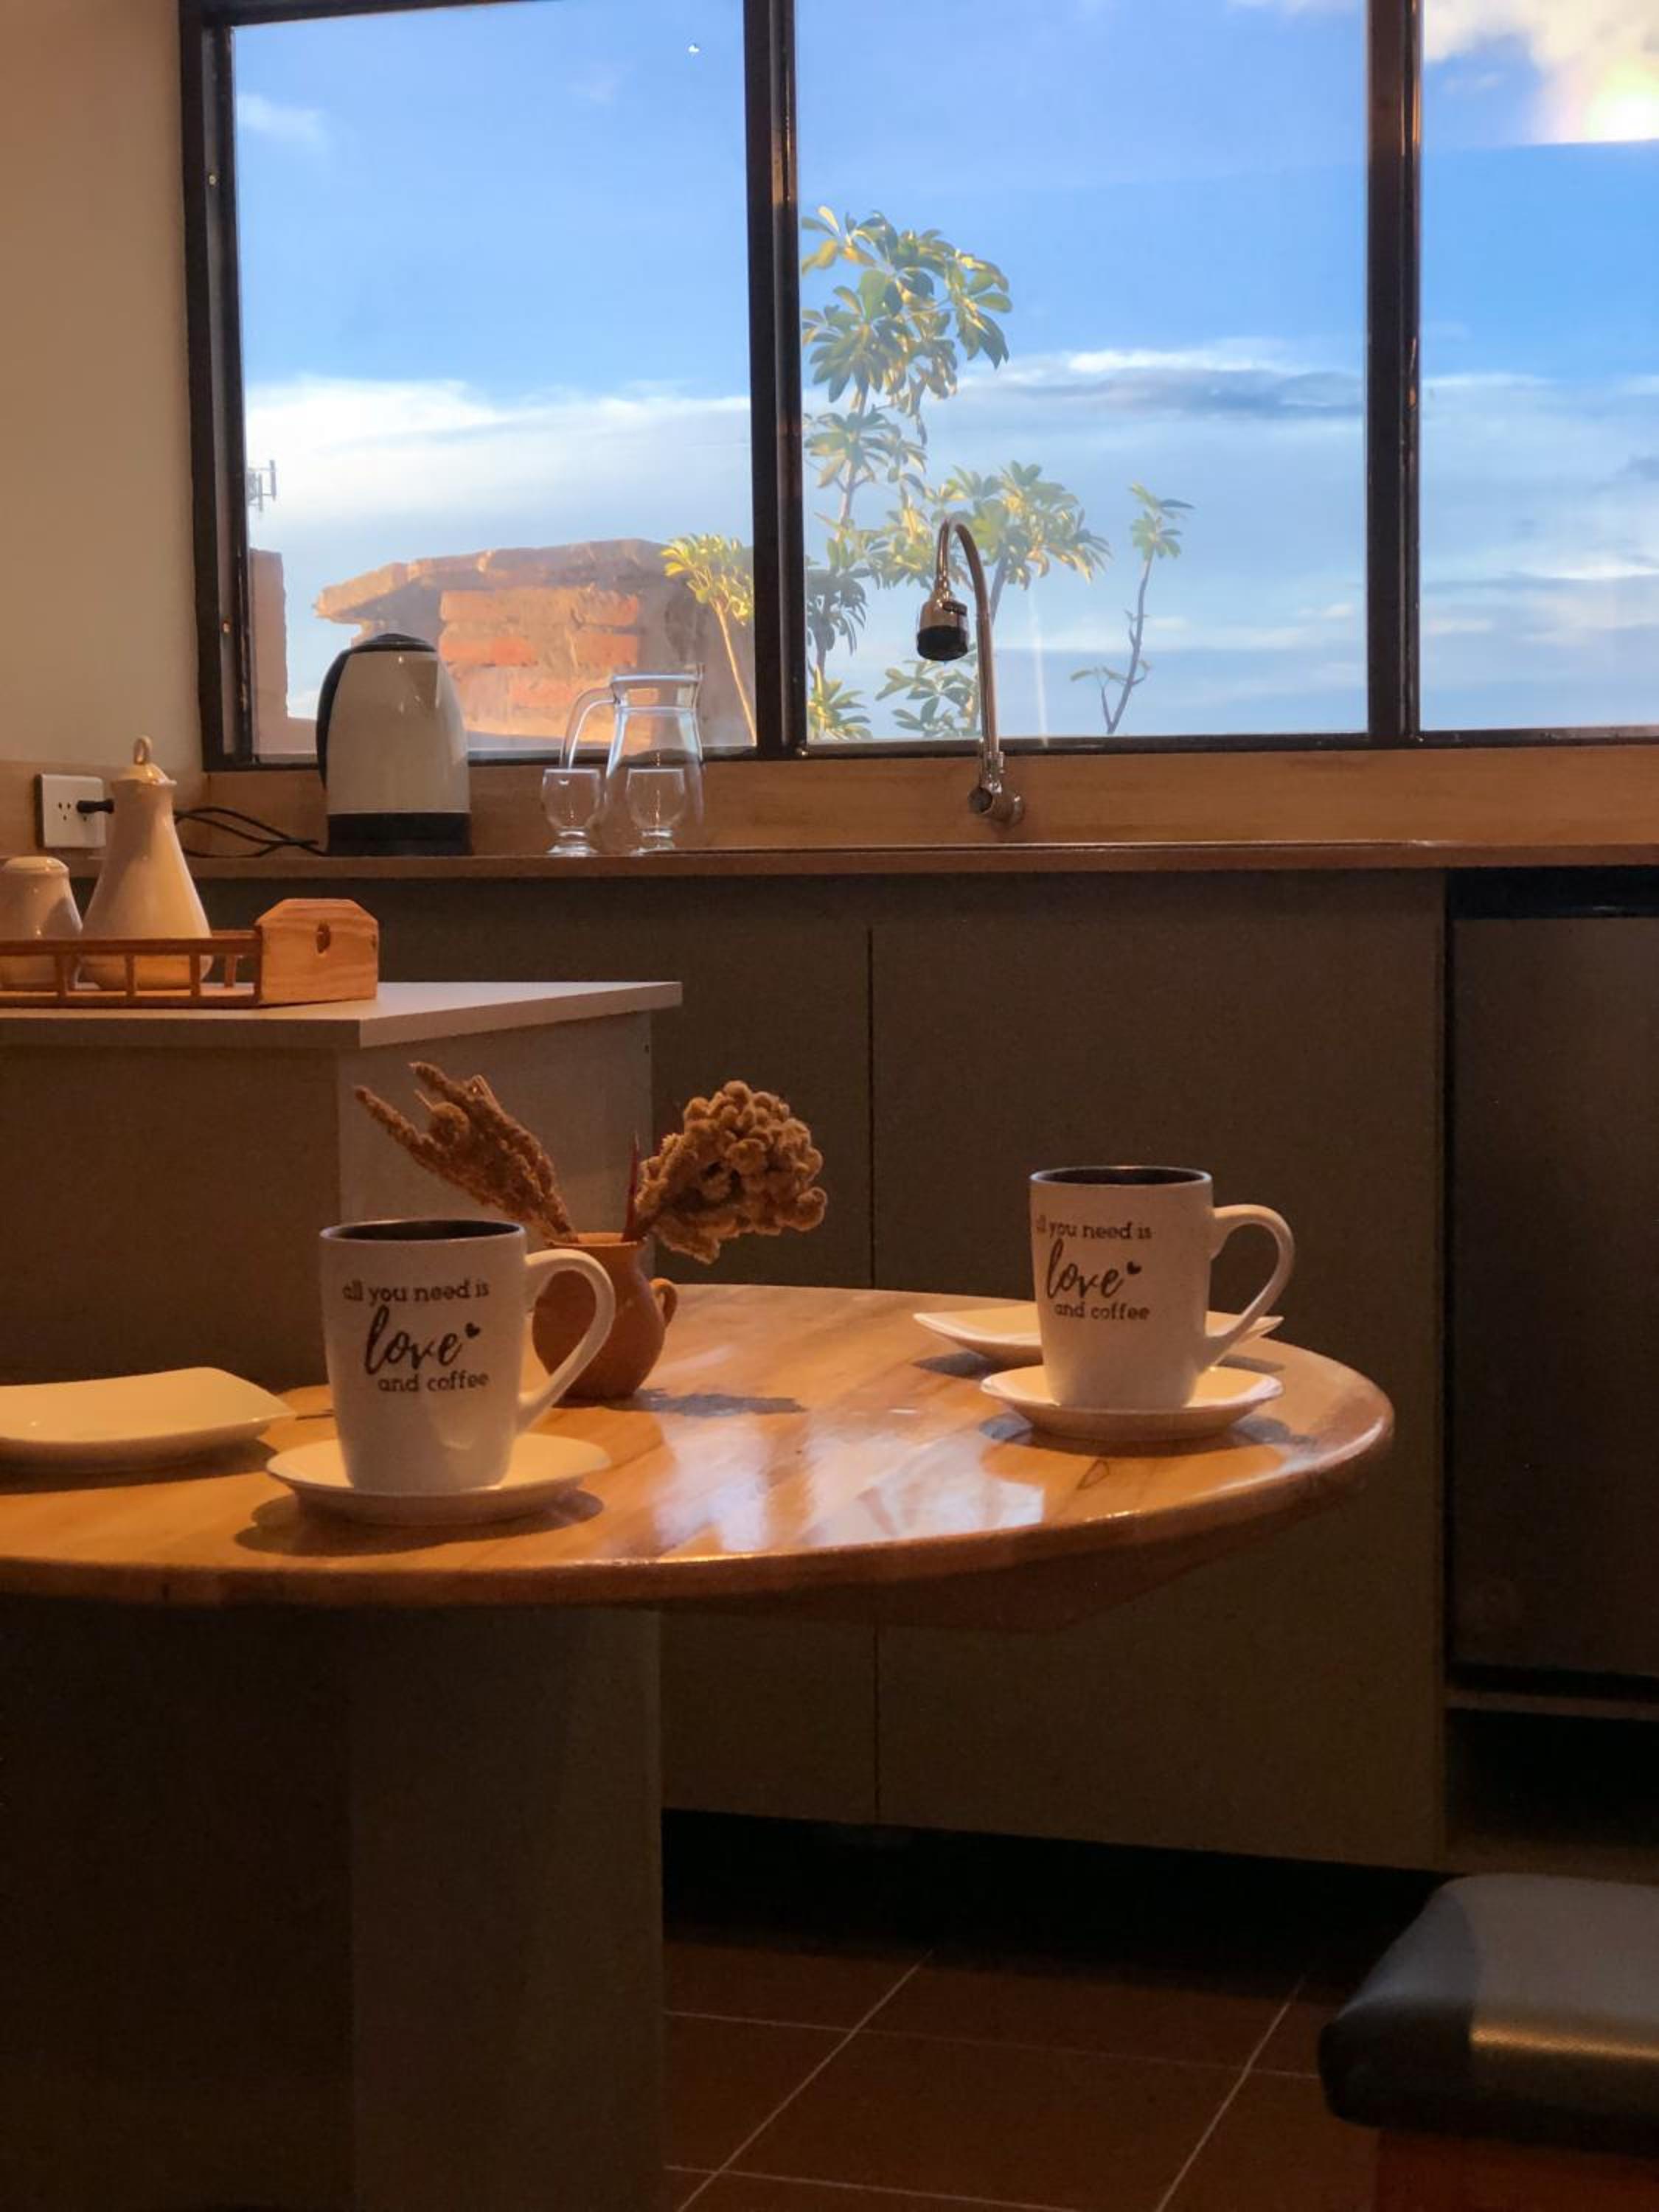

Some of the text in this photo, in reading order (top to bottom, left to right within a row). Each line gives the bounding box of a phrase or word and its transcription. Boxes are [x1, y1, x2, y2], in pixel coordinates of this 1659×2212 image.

[1049, 1221, 1077, 1239] you
[1082, 1220, 1133, 1239] need
[1138, 1225, 1152, 1239] is
[1046, 1238, 1124, 1299] love
[368, 1286, 407, 1307] you
[414, 1279, 470, 1302] need
[475, 1281, 490, 1298] is
[1054, 1301, 1150, 1320] and coffee
[364, 1304, 463, 1376] love
[378, 1369, 490, 1392] and coffee
